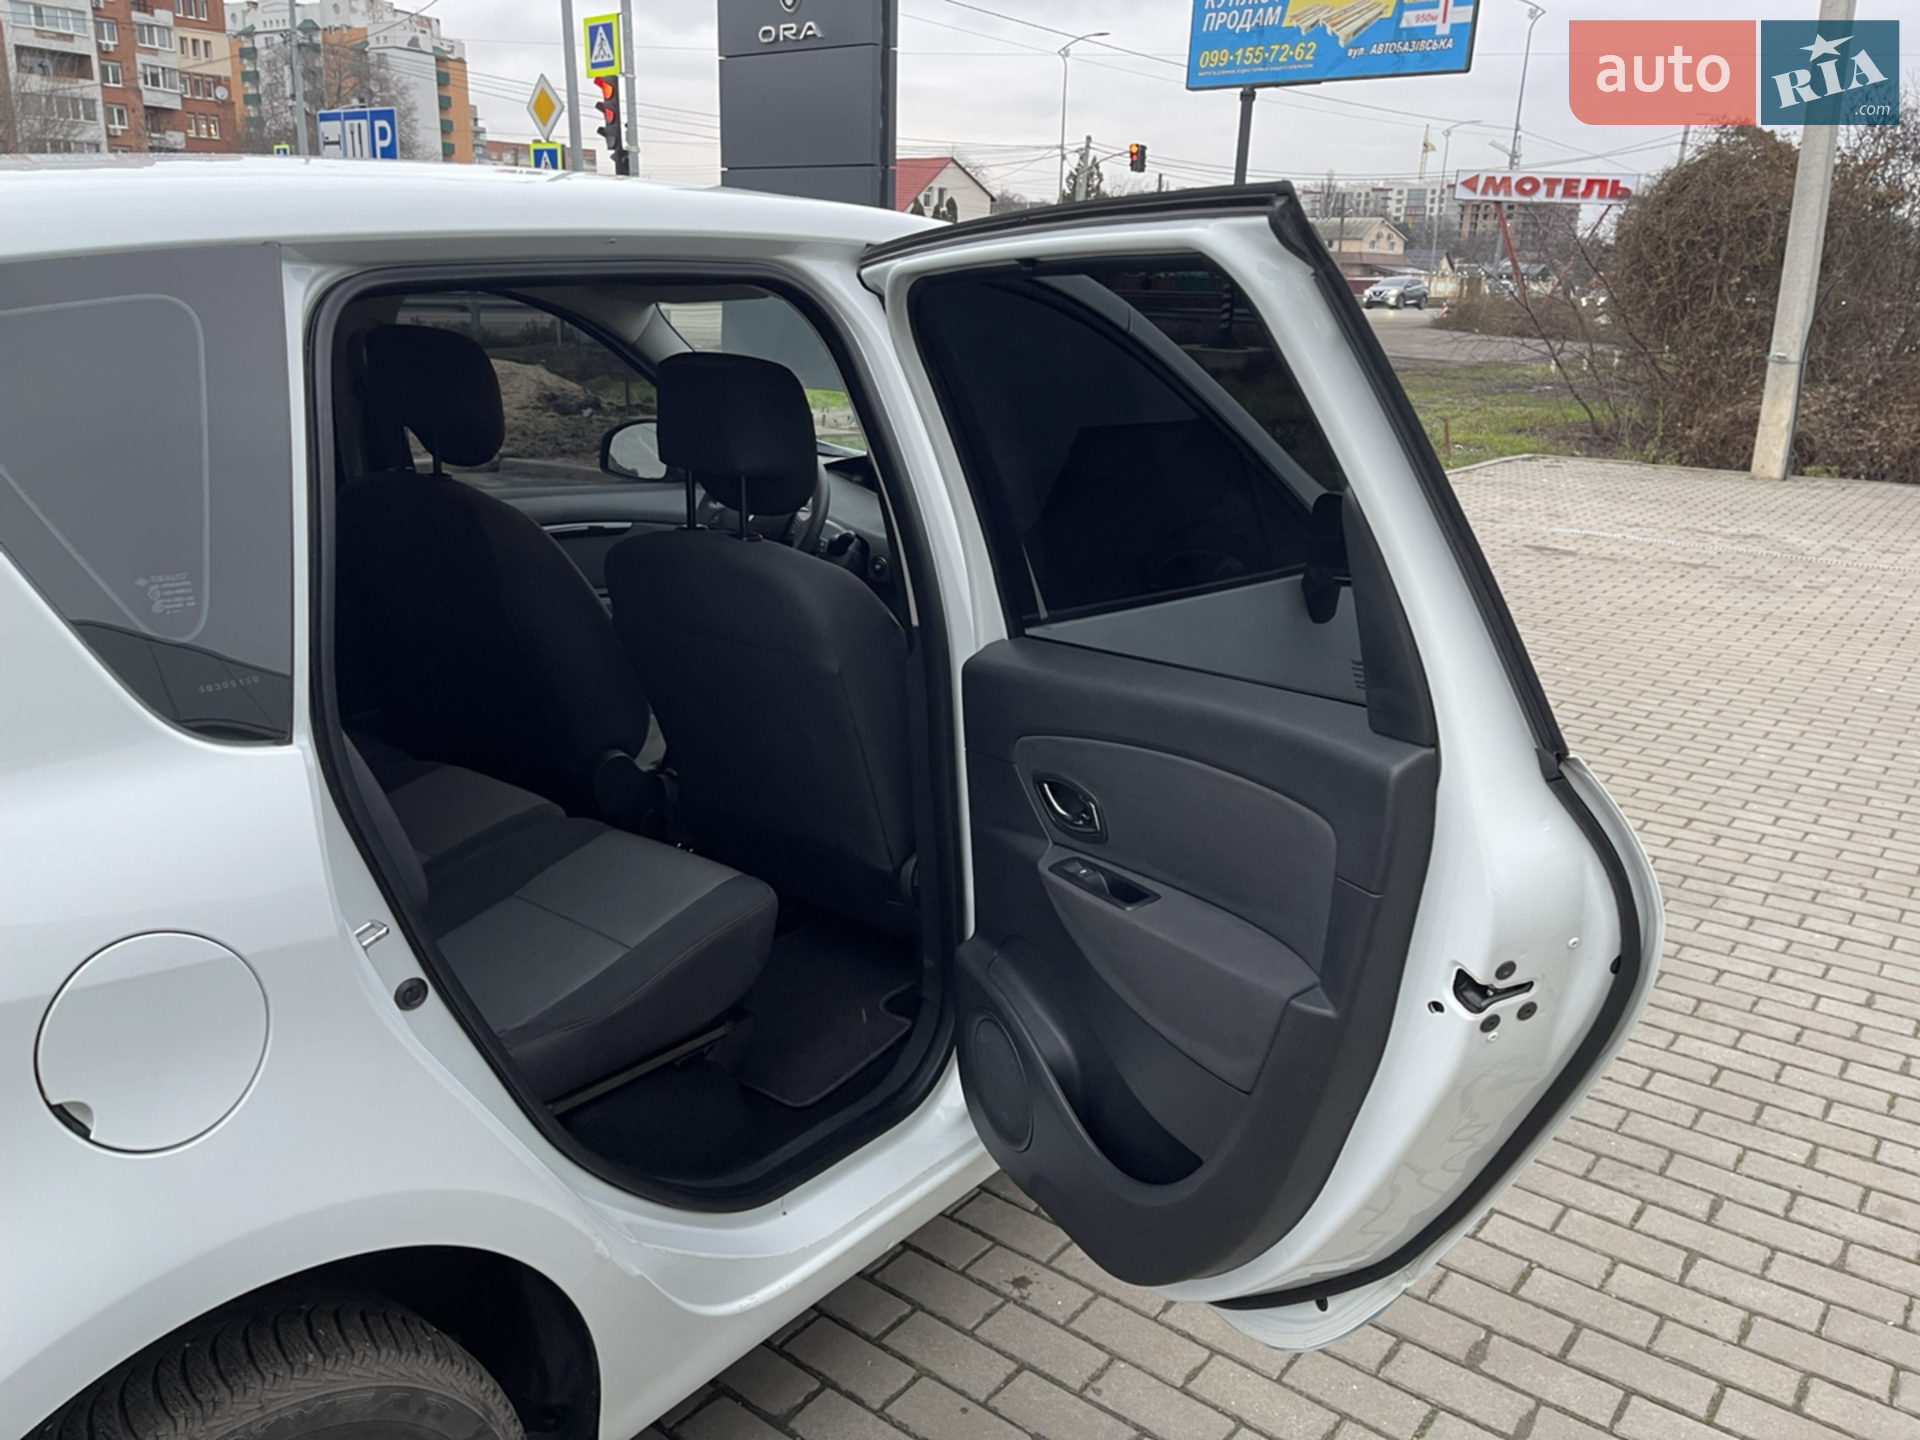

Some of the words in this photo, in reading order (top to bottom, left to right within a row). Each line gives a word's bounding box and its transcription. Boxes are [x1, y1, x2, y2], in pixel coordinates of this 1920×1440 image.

[1202, 5, 1283, 34] ПРОДАМ
[758, 21, 824, 43] ORA
[1369, 37, 1453, 56] АВТОБАЗІВСЬКА
[374, 120, 392, 159] P
[1480, 175, 1632, 199] МОТЕЛЬ
